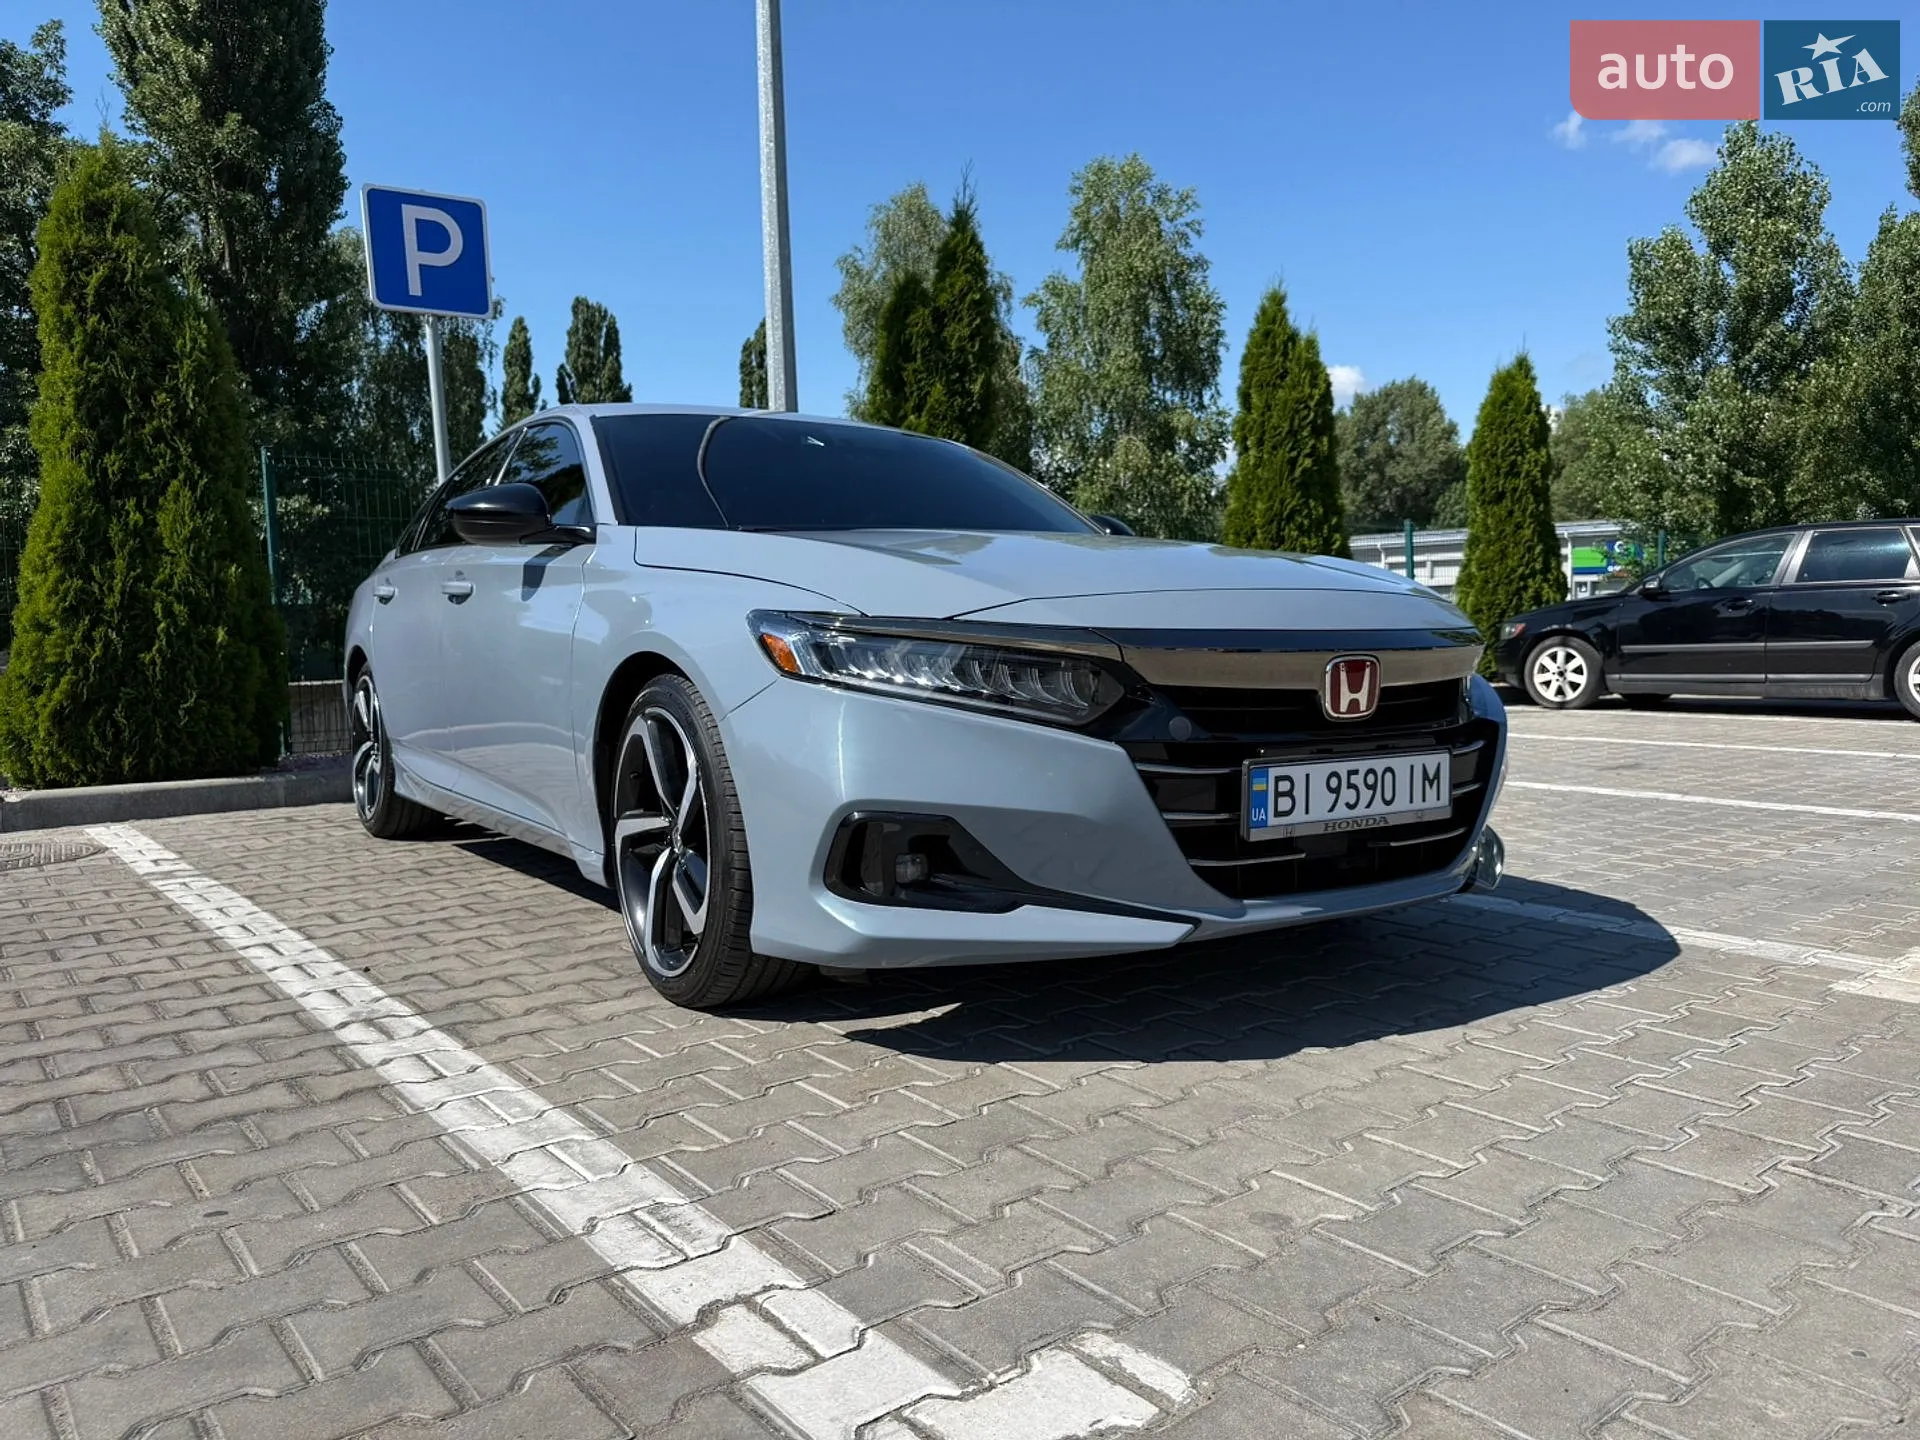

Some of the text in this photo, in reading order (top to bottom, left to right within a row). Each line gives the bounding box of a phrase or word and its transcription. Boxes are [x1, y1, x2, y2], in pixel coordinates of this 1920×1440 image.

[401, 203, 464, 297] P
[1273, 762, 1441, 818] BI 9590 IM
[1251, 807, 1266, 822] UA
[1323, 816, 1389, 832] HONDA
